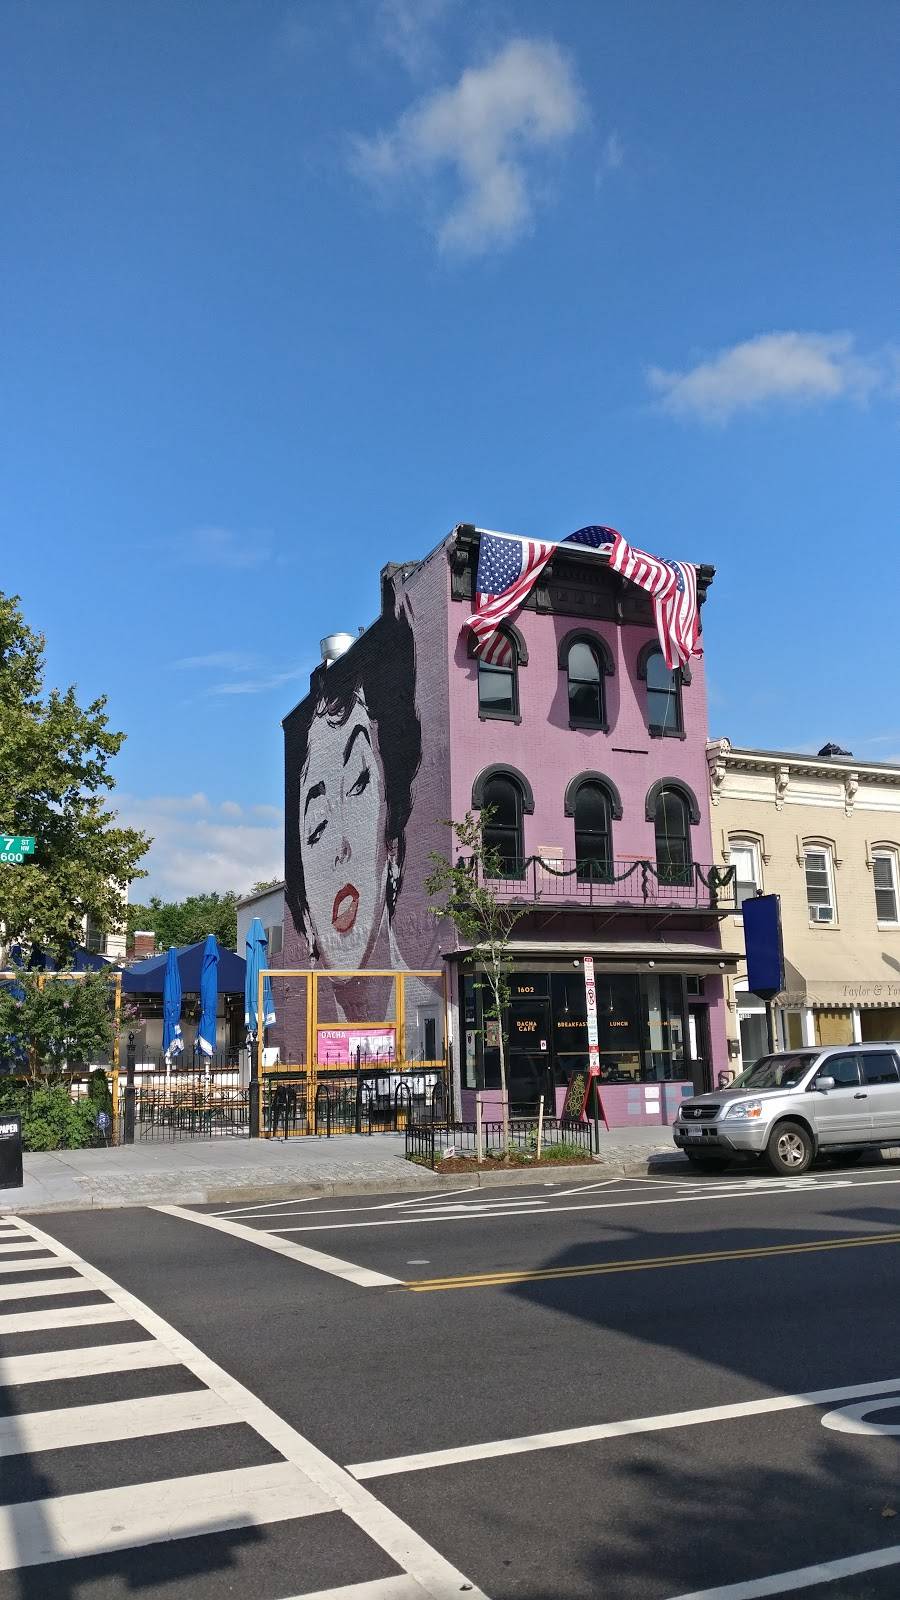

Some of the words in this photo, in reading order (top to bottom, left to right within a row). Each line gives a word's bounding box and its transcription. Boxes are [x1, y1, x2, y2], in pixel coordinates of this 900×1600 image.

[4, 838, 15, 851] 7
[0, 852, 23, 861] 600
[841, 984, 869, 999] Taylor
[874, 984, 882, 996] &
[887, 984, 900, 996] Yo
[321, 1031, 346, 1039] DACHA
